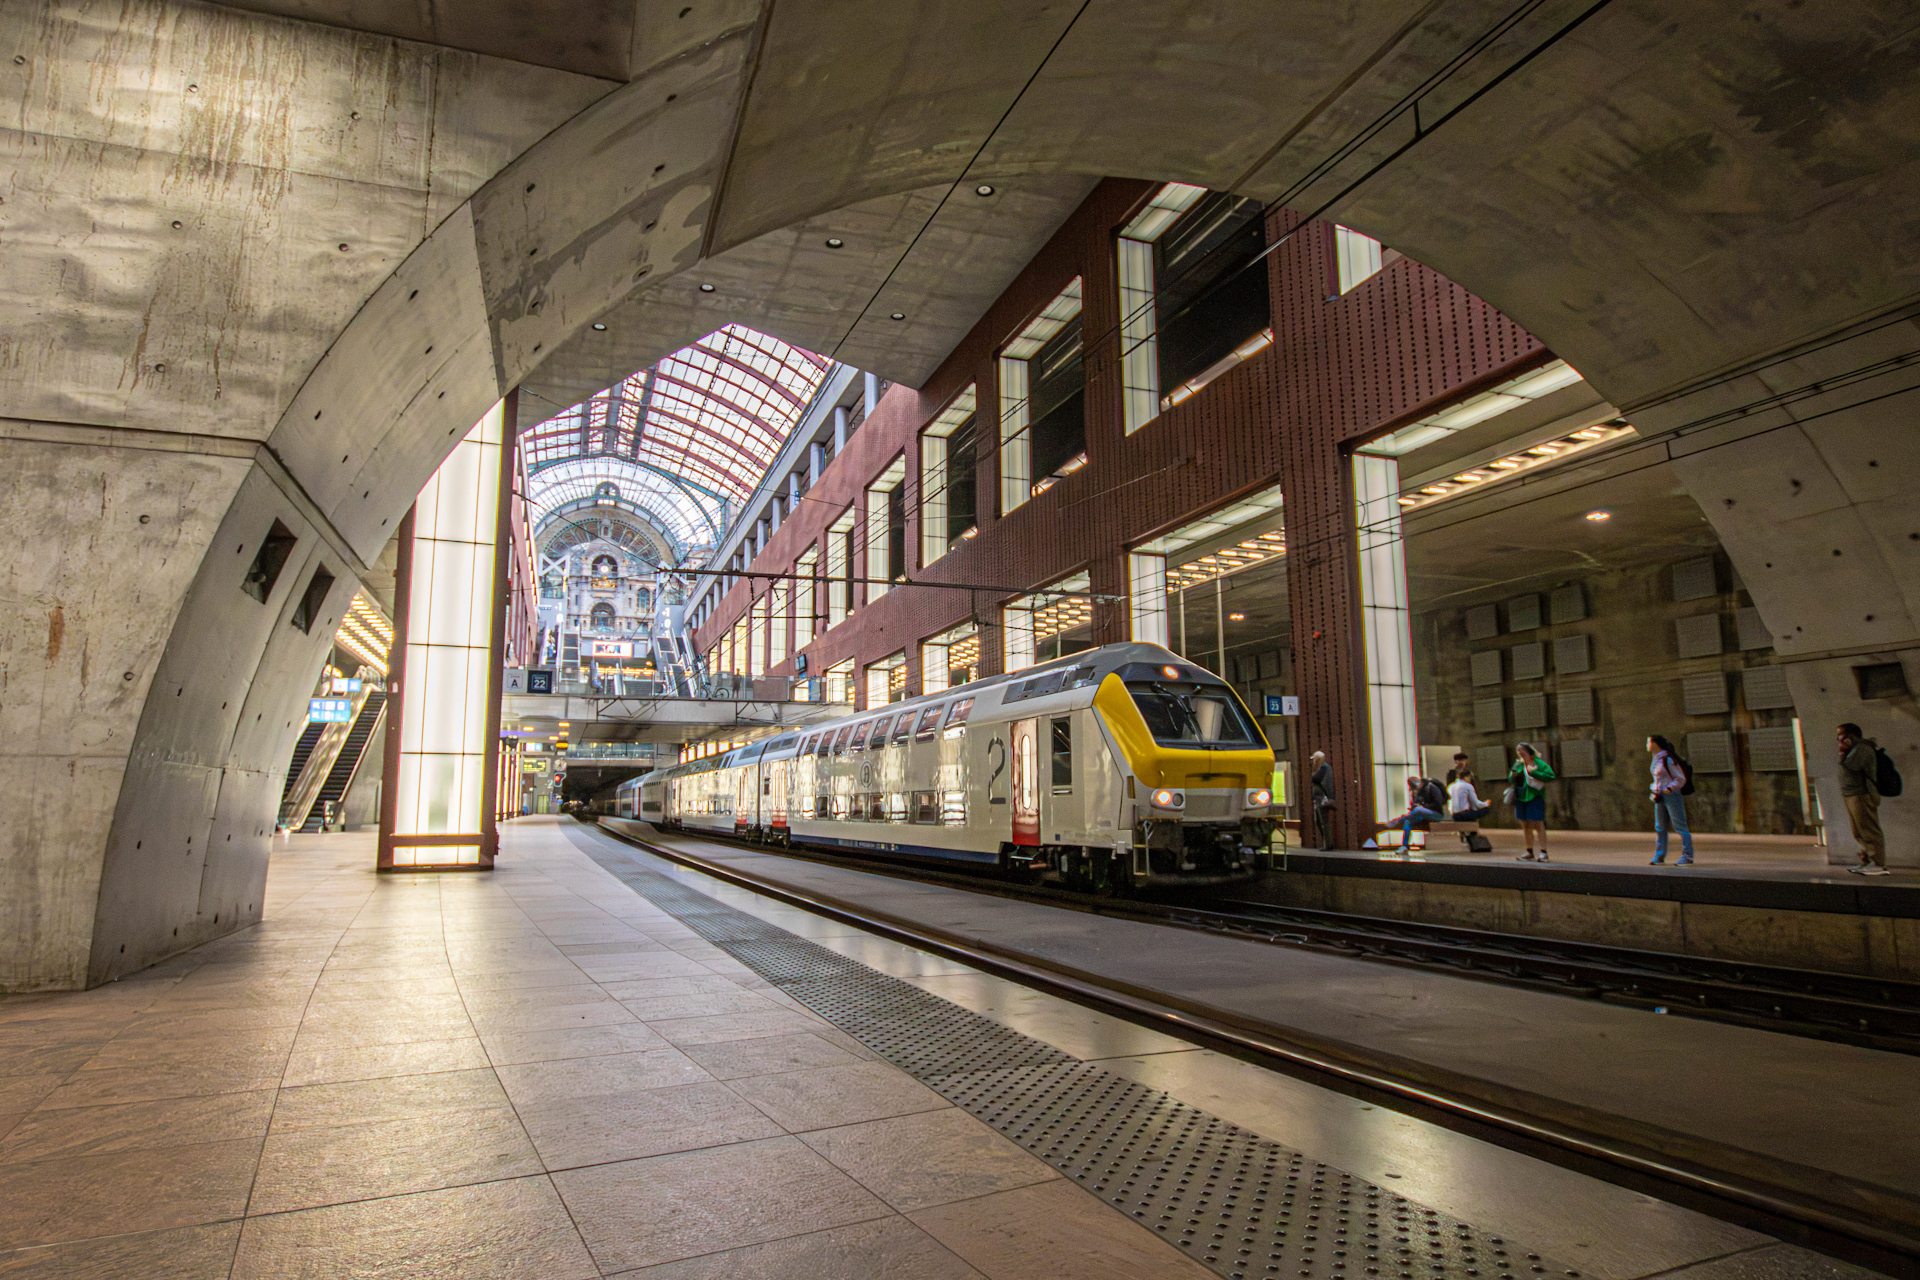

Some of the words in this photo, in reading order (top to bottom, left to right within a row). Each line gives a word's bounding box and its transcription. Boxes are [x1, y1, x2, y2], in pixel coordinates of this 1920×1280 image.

[511, 679, 518, 688] A
[534, 680, 546, 688] 22
[1270, 703, 1280, 711] 23
[988, 737, 1006, 804] 2
